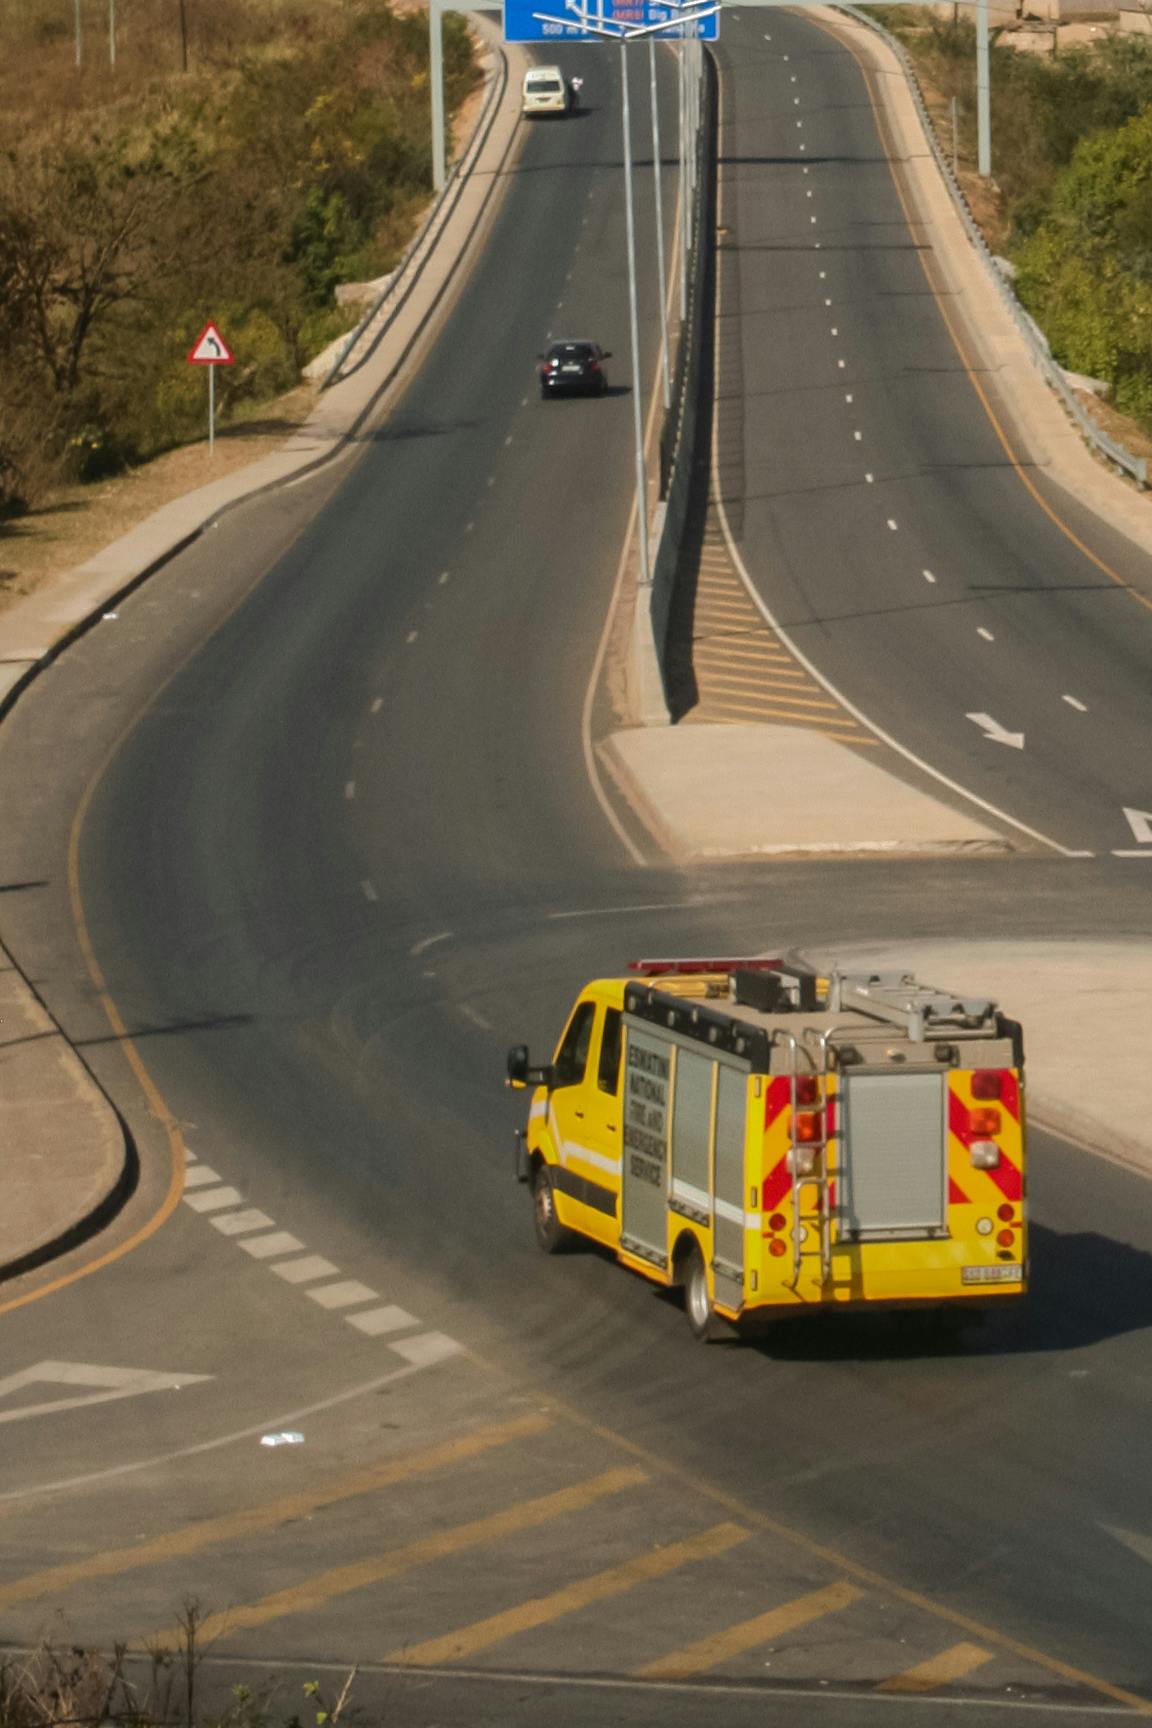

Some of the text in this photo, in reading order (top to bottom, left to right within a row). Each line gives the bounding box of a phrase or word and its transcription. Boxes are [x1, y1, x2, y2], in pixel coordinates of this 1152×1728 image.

[630, 1073, 665, 1107] NATIONAL
[630, 1099, 646, 1126] FIRE
[623, 1123, 667, 1162] EMERGENCY
[630, 1153, 661, 1187] SERVICE
